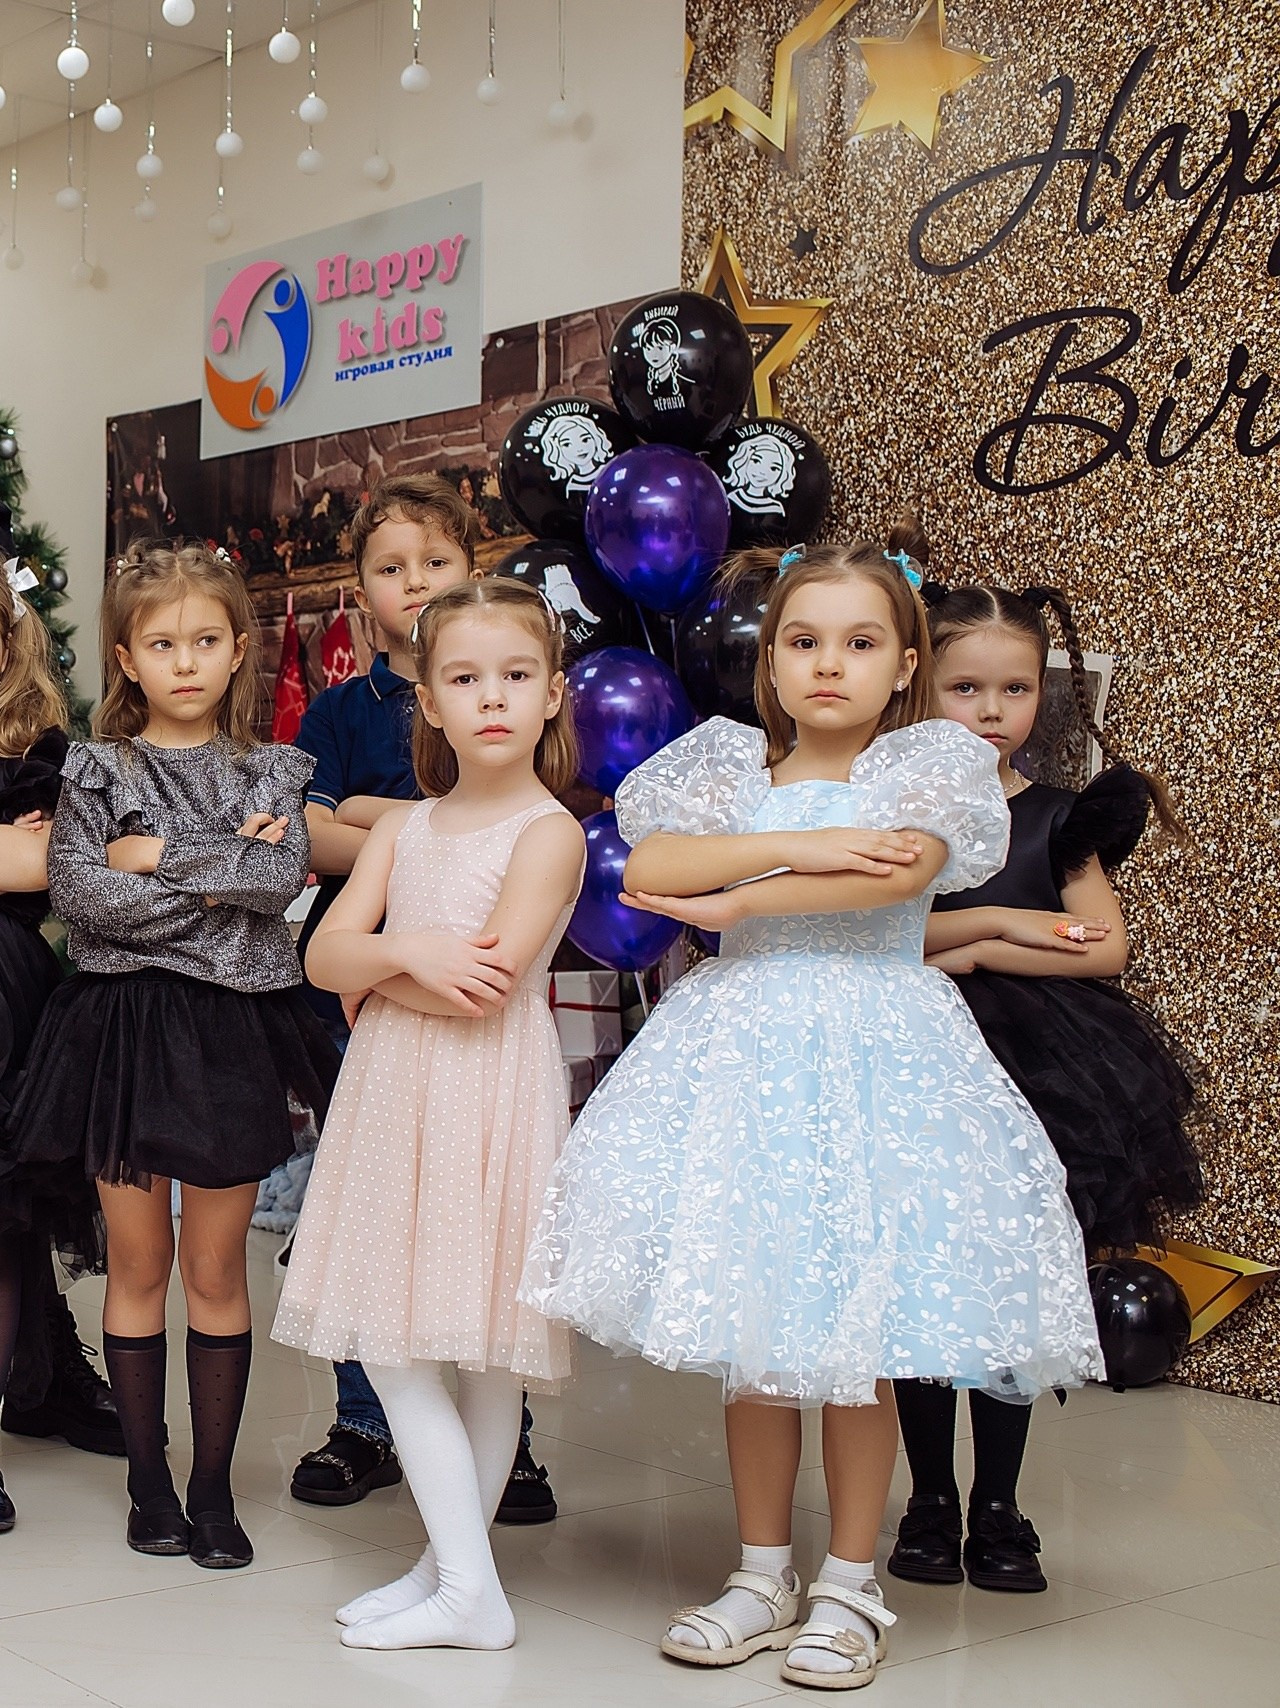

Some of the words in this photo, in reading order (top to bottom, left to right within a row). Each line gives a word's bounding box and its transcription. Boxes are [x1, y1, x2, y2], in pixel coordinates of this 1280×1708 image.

[315, 233, 466, 303] Happy
[644, 304, 679, 322] ВЫБИРАЙ
[337, 301, 444, 363] kids
[335, 359, 395, 381] игровая
[399, 346, 453, 367] студия
[544, 402, 590, 417] ЧУДНОЙ
[765, 423, 806, 450] ЧУДНОЙ
